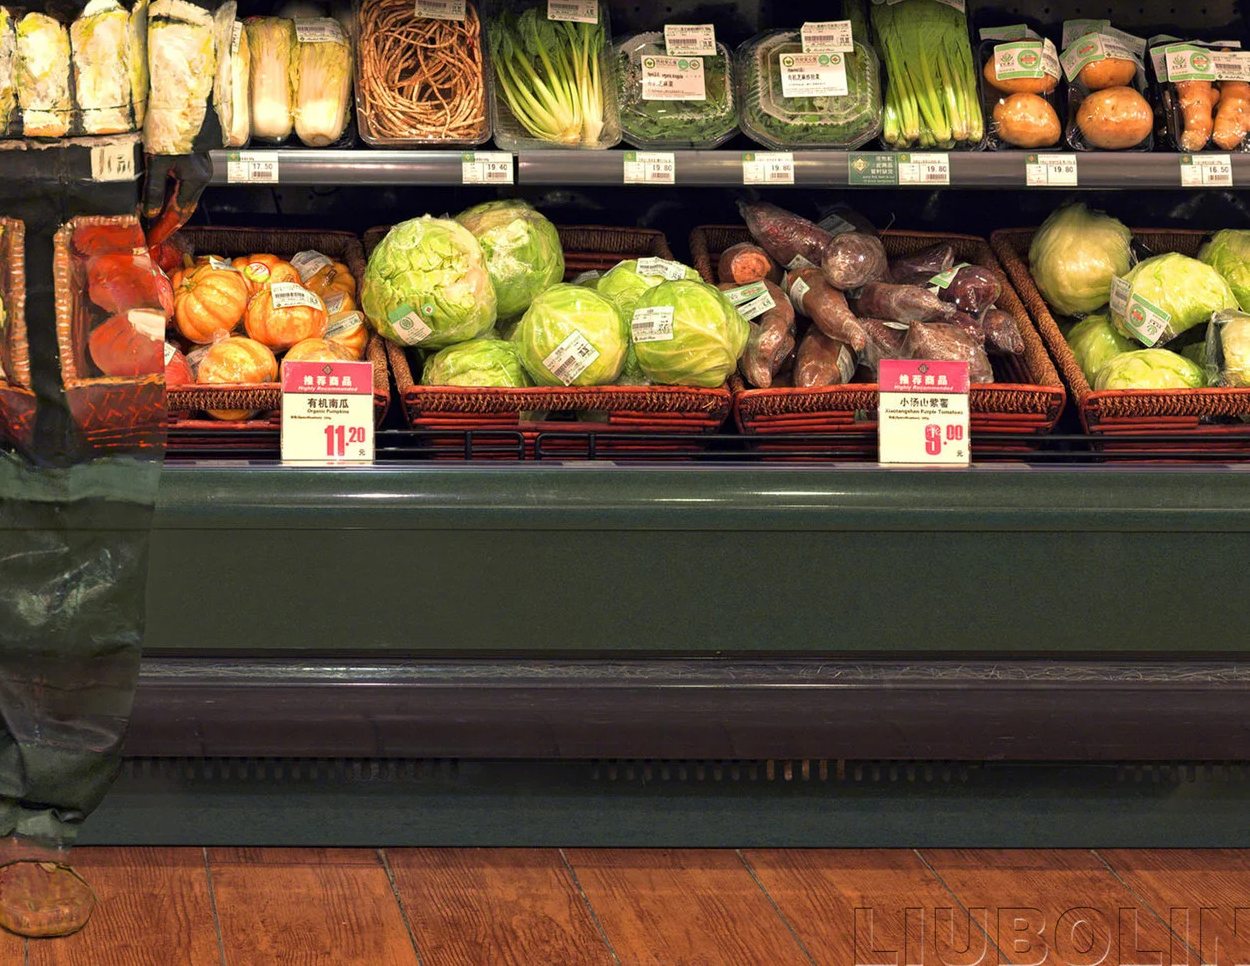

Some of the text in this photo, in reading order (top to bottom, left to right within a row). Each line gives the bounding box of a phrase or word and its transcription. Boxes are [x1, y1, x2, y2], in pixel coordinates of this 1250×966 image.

[253, 163, 274, 171] 17.50
[487, 163, 508, 172] 19.40
[652, 164, 673, 172] 19.80
[926, 165, 948, 174] 19.80
[1053, 166, 1074, 174] 19.80
[303, 375, 353, 387] 推荐商品
[899, 374, 948, 386] 推荐商品
[307, 398, 350, 409] 有机南瓜
[324, 425, 366, 457] 11.20
[956, 449, 964, 458] 元
